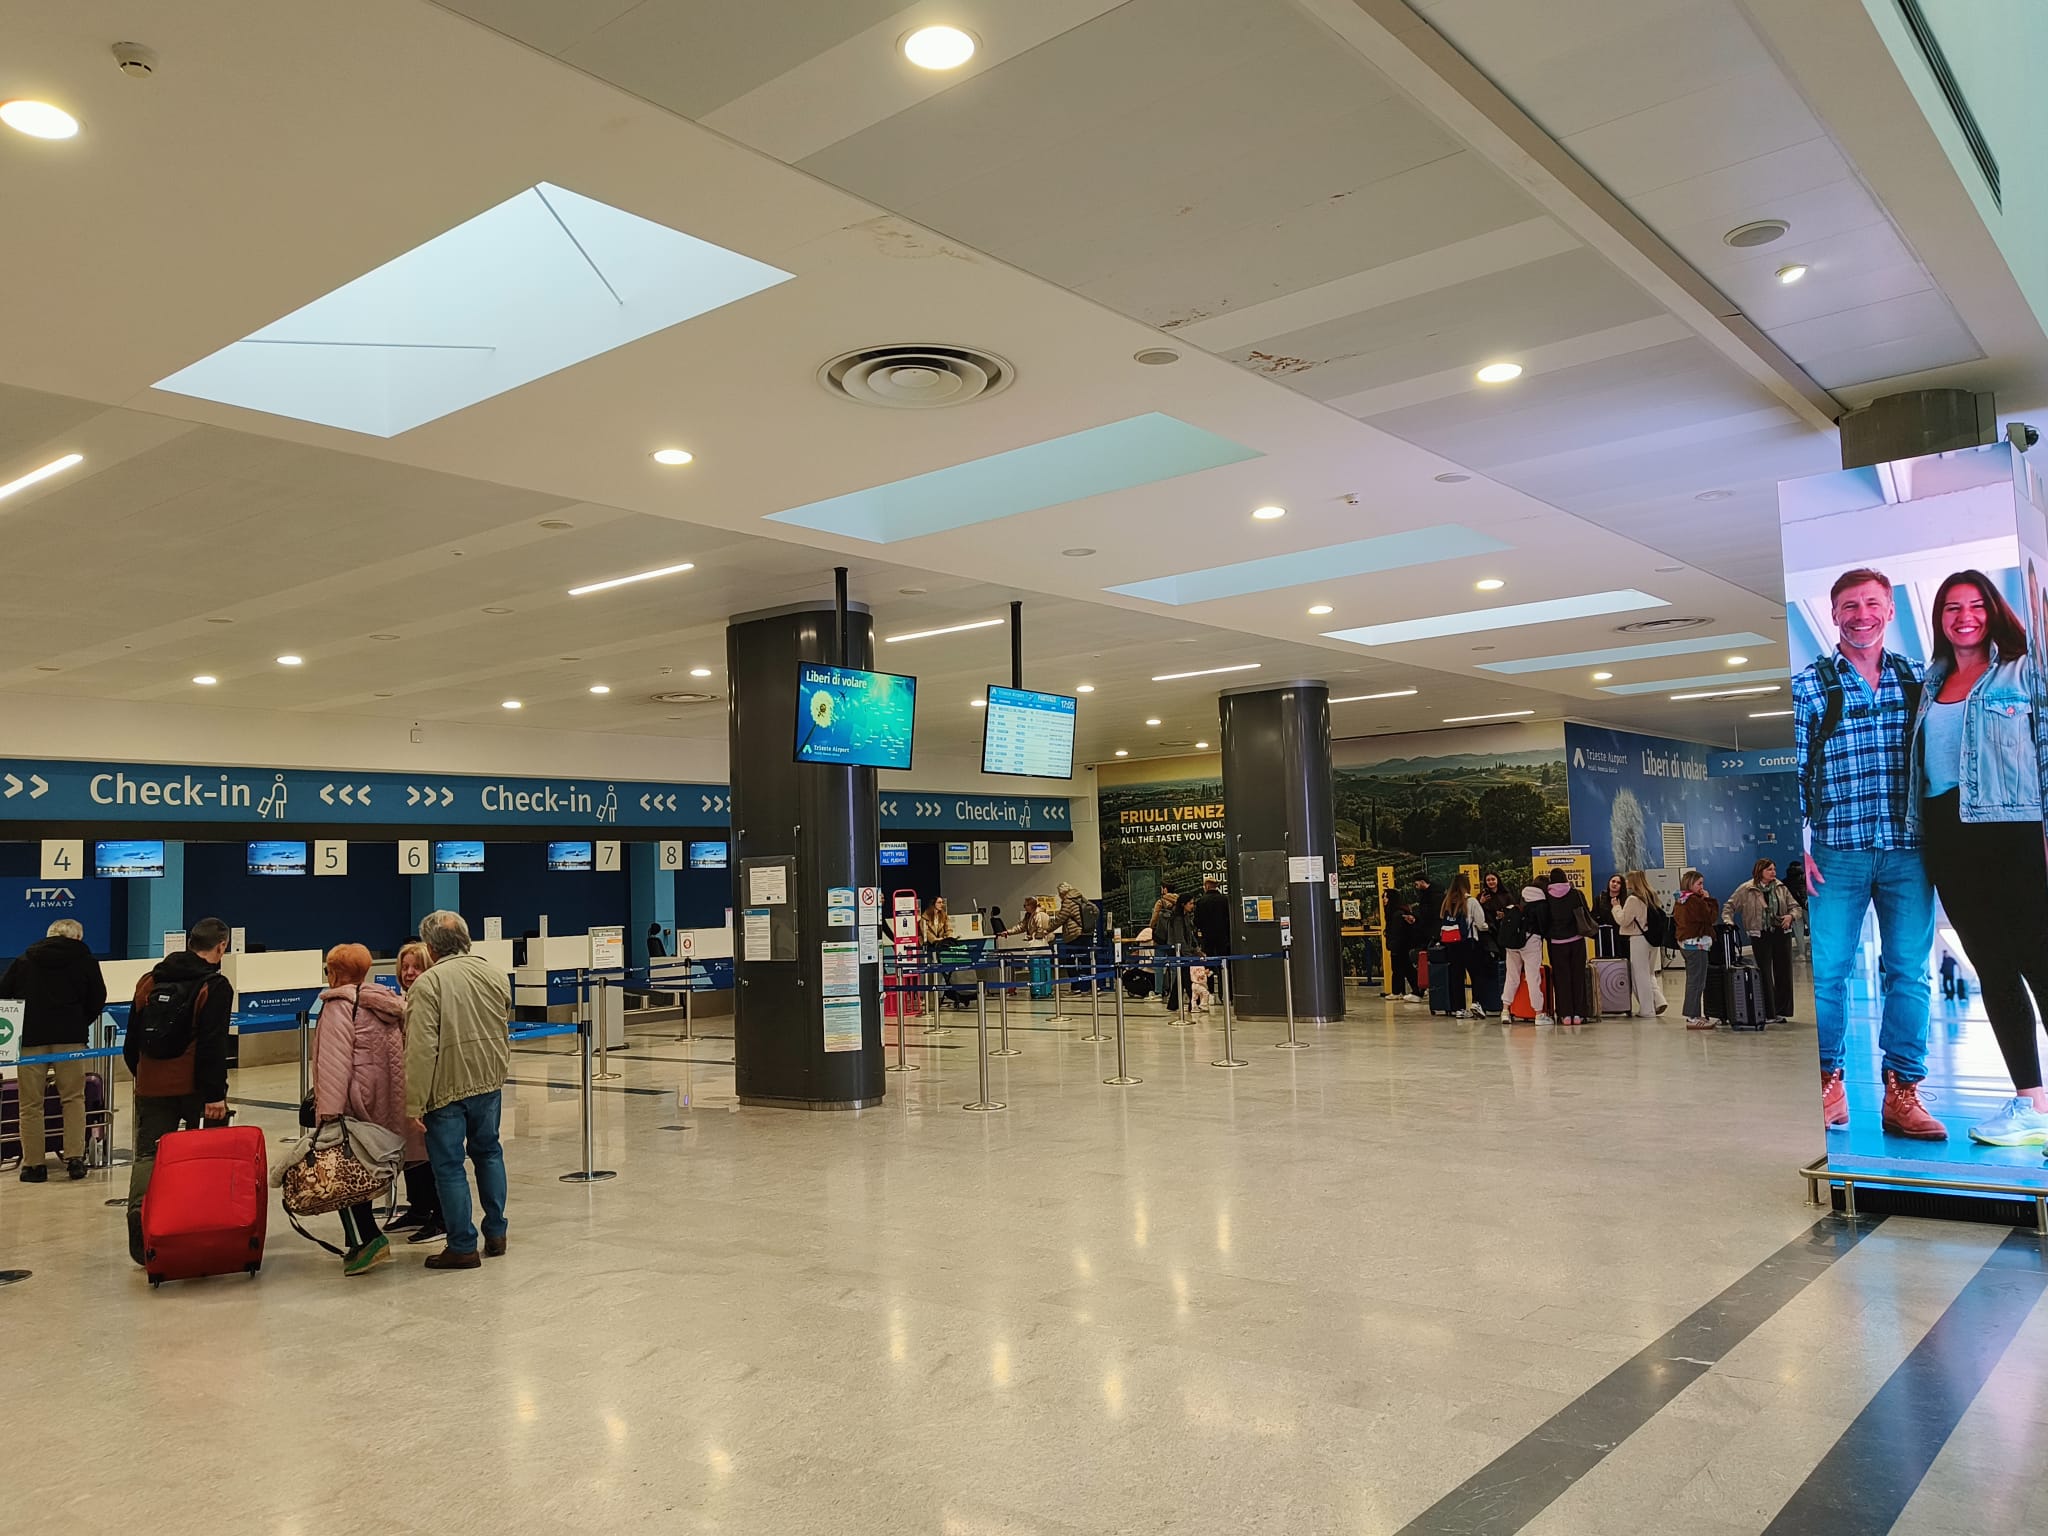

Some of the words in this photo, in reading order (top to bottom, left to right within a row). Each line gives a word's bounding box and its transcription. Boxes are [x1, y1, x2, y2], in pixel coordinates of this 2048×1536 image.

[806, 670, 830, 684] Liberi
[832, 674, 841, 686] di
[842, 677, 868, 689] volare
[1586, 749, 1607, 762] Trieste
[1608, 752, 1628, 765] Airport
[1642, 749, 1669, 777] Liberi
[1671, 752, 1680, 778] di
[1682, 756, 1708, 780] volare
[1759, 756, 1797, 767] Contro
[90, 773, 250, 806] Check-in
[481, 785, 592, 813] Check-in
[956, 801, 1017, 822] Check-in
[1121, 808, 1168, 824] FRIULI
[1173, 805, 1225, 820] VENEZ
[1121, 826, 1143, 834] TUTTI
[1150, 824, 1180, 833] SAPORI
[1182, 823, 1198, 831] CHE
[1157, 834, 1182, 843] TASTE
[1184, 833, 1201, 841] YOU
[54, 848, 71, 871] 4
[325, 847, 338, 869] 5
[408, 846, 421, 867] 6
[603, 846, 614, 865] 7
[666, 846, 677, 864] 8
[975, 846, 987, 860] 11
[1012, 846, 1024, 860] 12
[1203, 861, 1213, 871] IO
[25, 887, 76, 900] ITA
